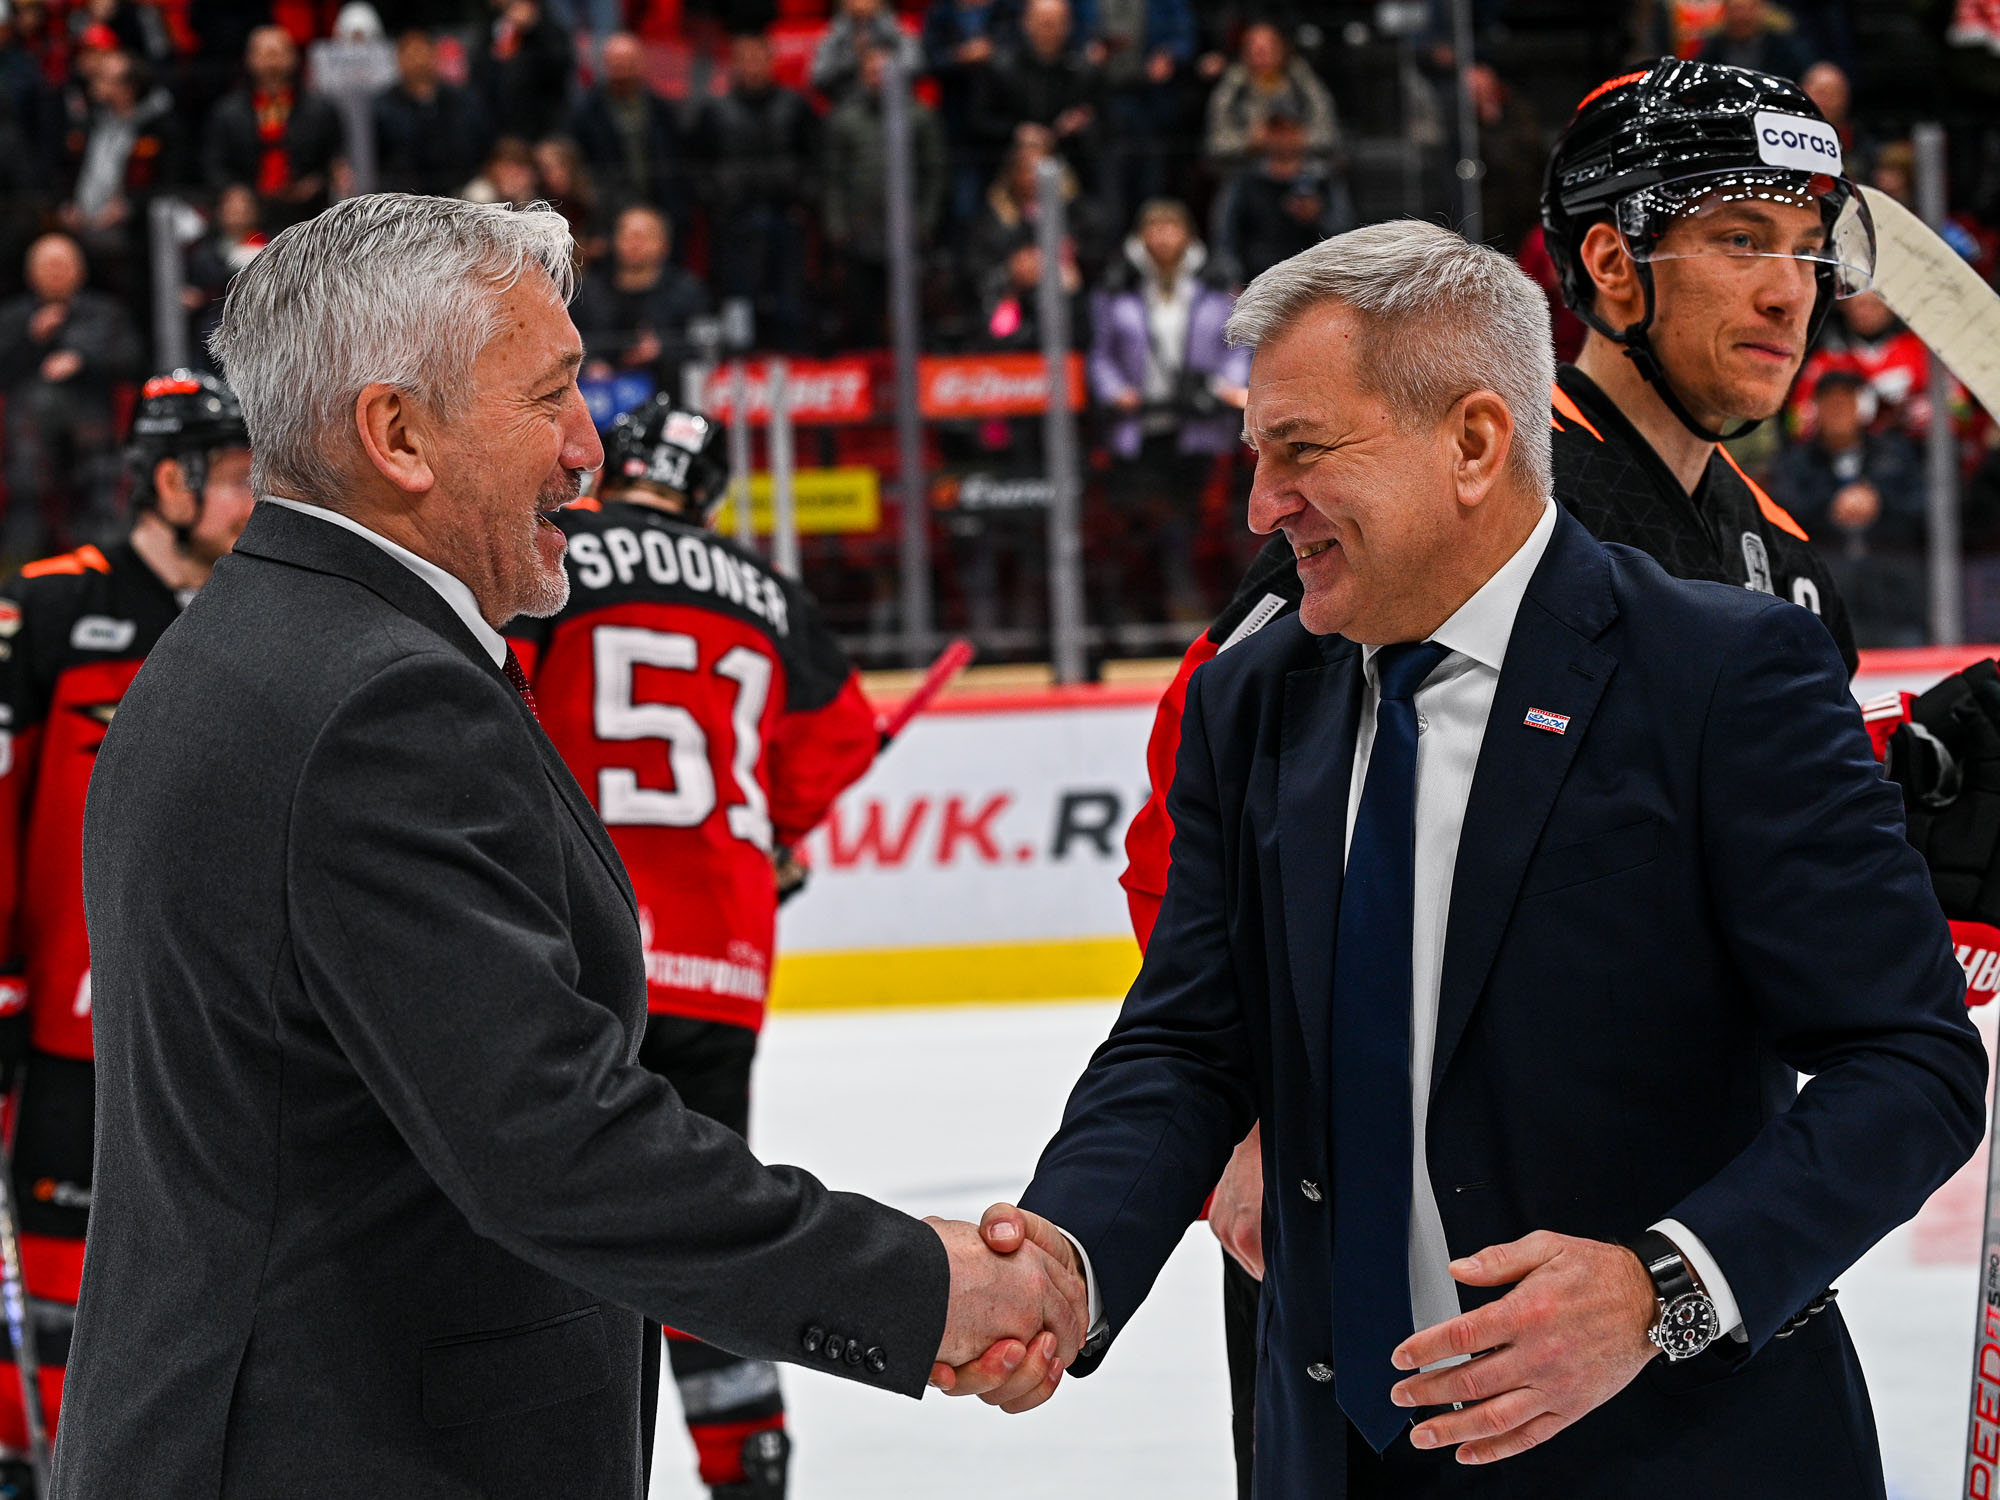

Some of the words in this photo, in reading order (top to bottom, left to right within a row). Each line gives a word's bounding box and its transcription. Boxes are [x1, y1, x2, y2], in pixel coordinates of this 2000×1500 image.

[1562, 163, 1609, 187] CCM
[1762, 128, 1838, 159] согаз
[567, 527, 789, 638] SPOONER
[593, 624, 773, 854] 51
[795, 788, 1152, 869] WK.R
